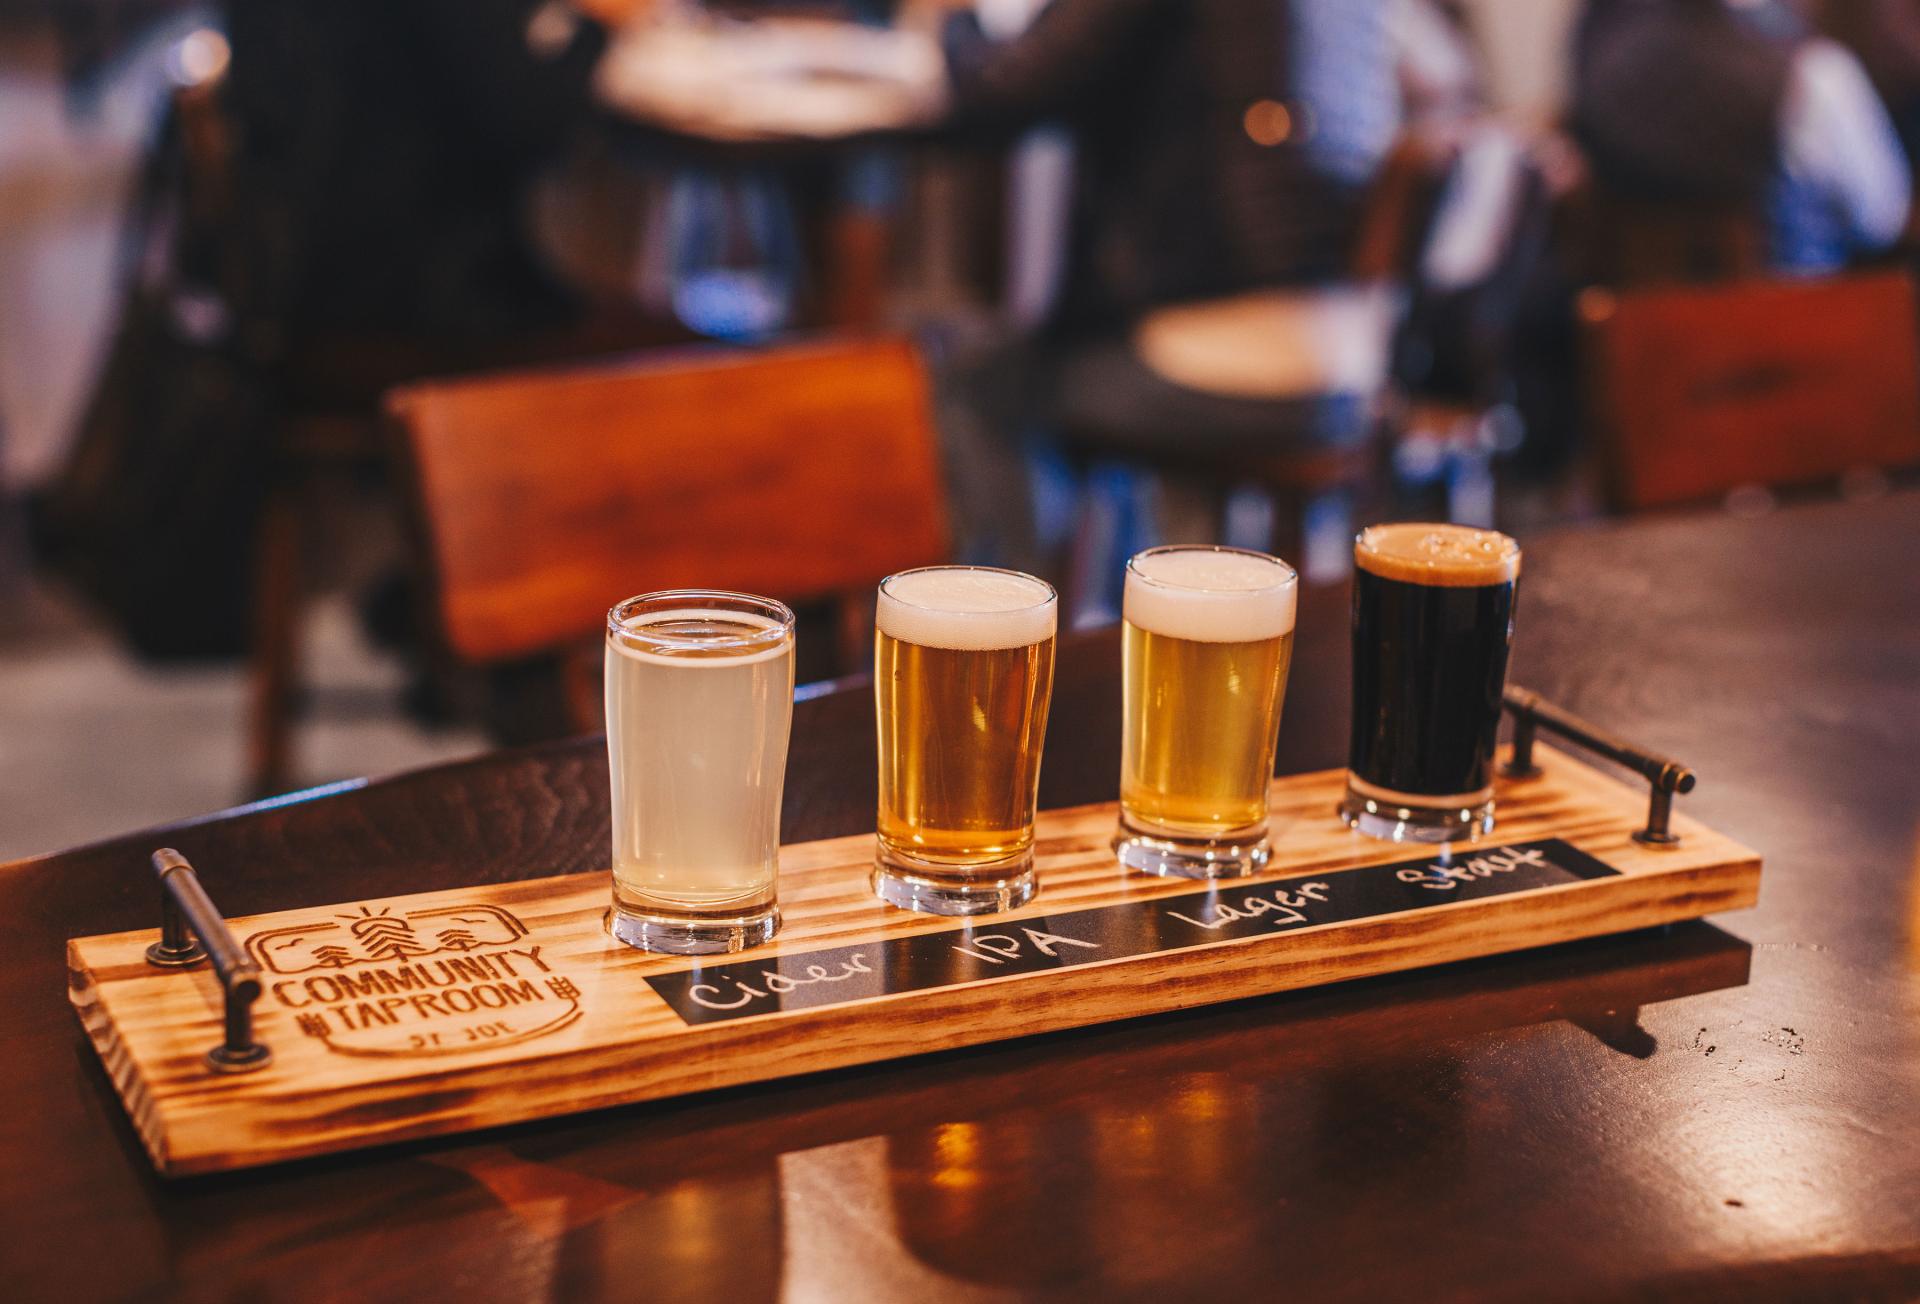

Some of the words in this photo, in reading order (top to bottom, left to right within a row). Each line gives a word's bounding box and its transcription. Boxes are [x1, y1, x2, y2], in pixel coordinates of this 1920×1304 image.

[689, 952, 875, 1010] Cider
[952, 927, 1099, 964] IPA
[1167, 882, 1330, 930] Lager
[1396, 846, 1544, 890] Stout
[272, 946, 551, 1008] COMMUNITY
[330, 979, 544, 1030] TAPROOM
